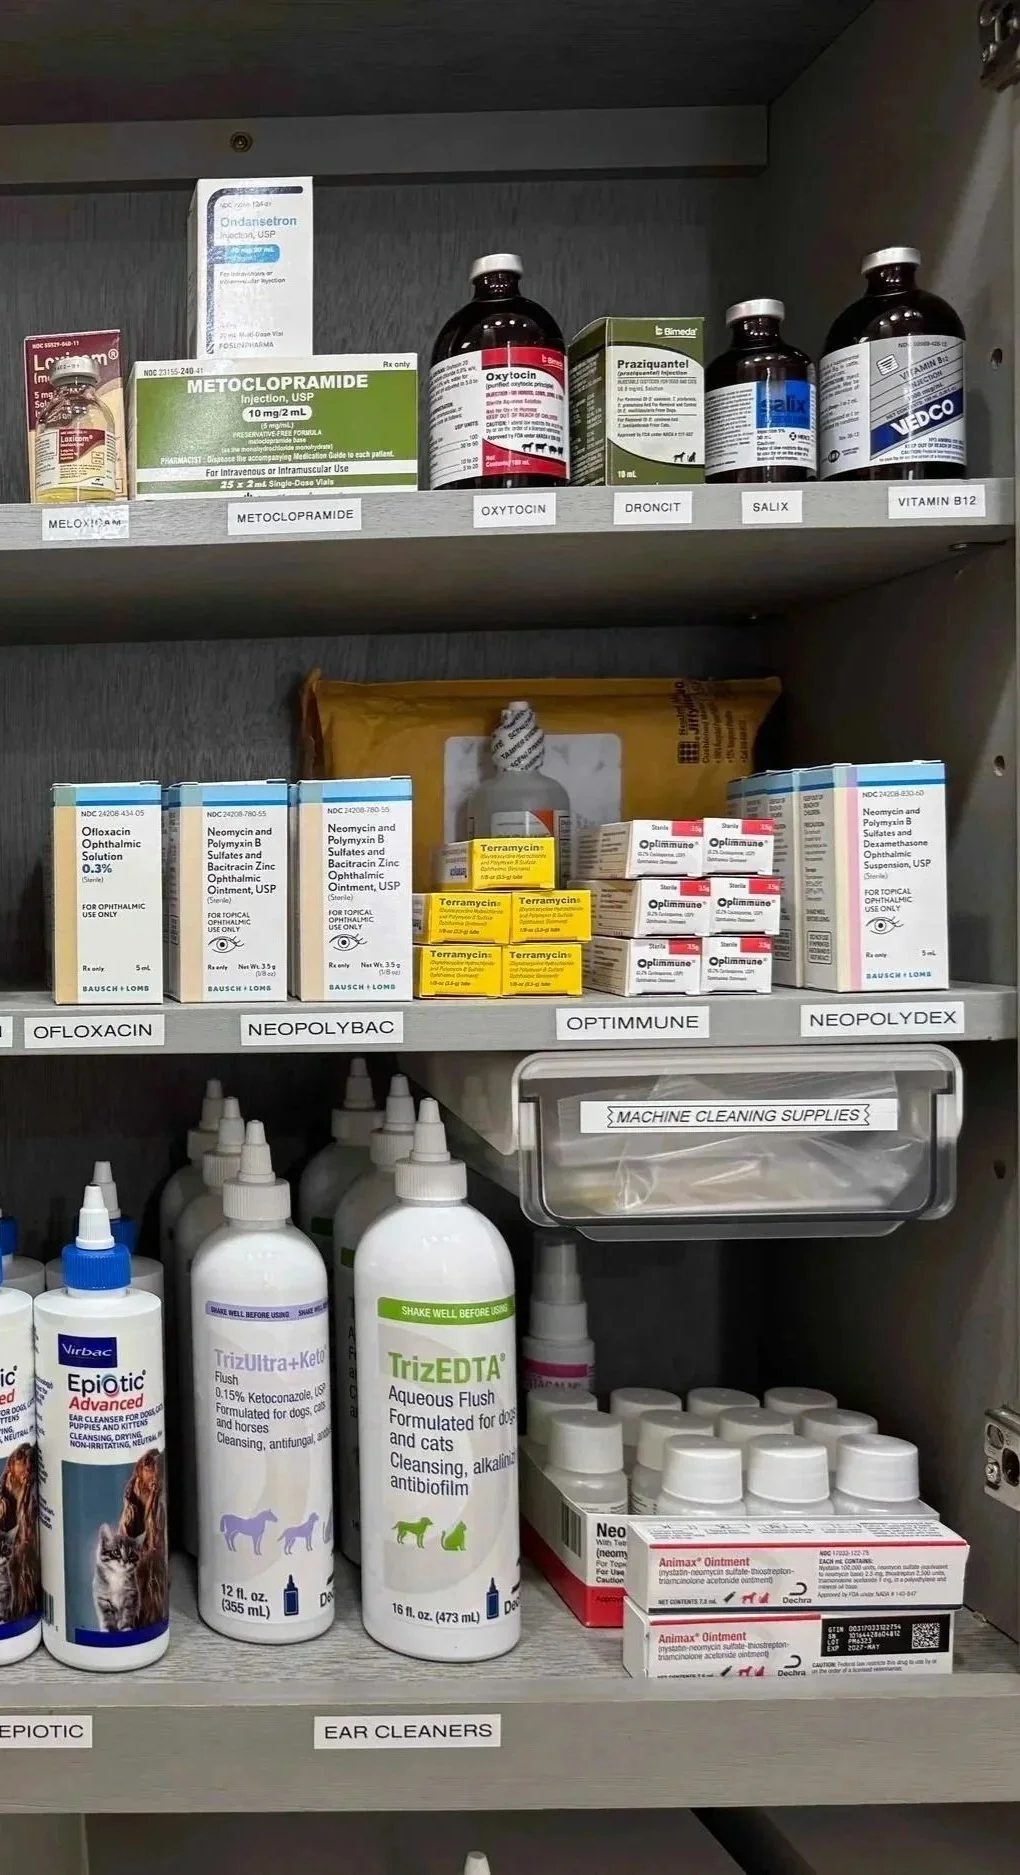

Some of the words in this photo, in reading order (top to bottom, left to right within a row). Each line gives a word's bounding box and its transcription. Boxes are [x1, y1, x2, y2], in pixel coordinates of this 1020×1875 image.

[220, 216, 297, 227] Ondansetron
[394, 361, 410, 369] only
[617, 359, 689, 370] Praziquantel
[486, 371, 536, 382] Oxytocin
[187, 375, 368, 393] METOCLOPRAMIDE
[241, 394, 289, 403] Injection,
[292, 393, 314, 402] USP
[249, 409, 261, 417] 10
[263, 408, 288, 419] mg/2
[290, 408, 306, 416] mL
[891, 400, 954, 434] VEDCO
[220, 467, 265, 476] Intravenous
[278, 466, 331, 475] Intramuscular
[334, 464, 348, 473] Use
[618, 470, 625, 478] 10
[753, 502, 788, 512] SALIX
[898, 497, 949, 507] VITAMIN
[954, 496, 976, 506] B12
[482, 504, 546, 516] OXYTOCIN
[626, 503, 681, 513] DRONCIT
[237, 509, 354, 523] METOCLOPRAMIDE
[863, 808, 903, 816] Neomycin
[82, 827, 130, 836] Ofloxacin
[207, 828, 253, 837] Neomycin
[255, 827, 272, 835] and
[82, 839, 141, 850] Ophthalmic
[208, 839, 253, 849] Polymyxin
[255, 839, 261, 847] B
[864, 839, 928, 847] Dexamethasone
[82, 852, 123, 861] Solution
[208, 851, 243, 859] Sulfates
[245, 850, 261, 859] and
[82, 864, 112, 873] 0.3%
[208, 862, 253, 871] Bacitracin
[255, 862, 275, 870] Zinc
[864, 861, 911, 869] Suspension,
[208, 874, 261, 884] Ophthalmic
[208, 885, 254, 895] Ointment,
[256, 885, 276, 893] USP
[567, 1016, 699, 1030] OPTIMMUNE
[810, 1011, 956, 1026] NEOPOLYDEX
[34, 1024, 152, 1039] OFLOXACIN
[248, 1021, 394, 1036] NEOPOLYBAC
[617, 1110, 691, 1123] MACHINE
[696, 1110, 776, 1122] CLEANING
[781, 1109, 860, 1121] SUPPLIES
[402, 1306, 431, 1317] SHAKE
[433, 1307, 458, 1318] WELL
[460, 1306, 489, 1317] BEFORE
[491, 1304, 508, 1314] USING
[61, 1343, 112, 1357] Virbac
[214, 1348, 325, 1371] TrizUltra+Keto
[215, 1371, 238, 1385] Flush
[69, 1393, 143, 1411] Advanced
[389, 1385, 453, 1408] Aqueous
[458, 1389, 495, 1406] Flush
[390, 1474, 468, 1496] antibiofilm
[704, 1556, 750, 1566] Ointment
[221, 1583, 233, 1595] 12
[236, 1587, 247, 1599] fl.
[251, 1592, 268, 1602] oz.
[222, 1599, 244, 1615] (355
[247, 1604, 270, 1619] mL)
[702, 1631, 746, 1642] Ointment
[325, 1726, 369, 1739] EAR
[375, 1724, 492, 1739] CLEANERS
